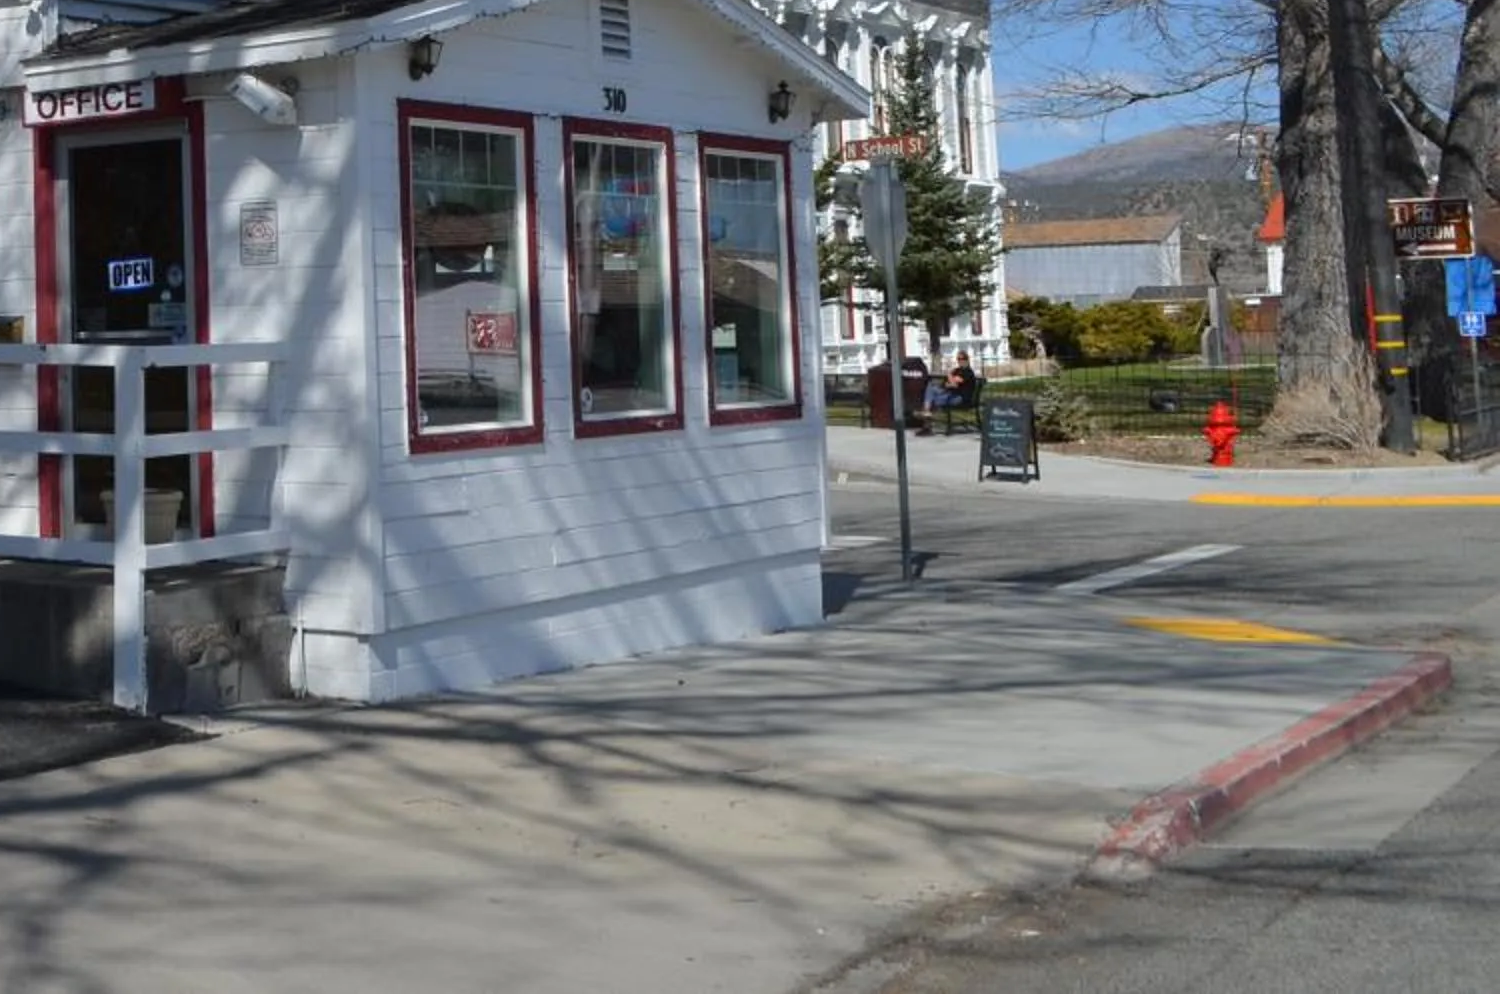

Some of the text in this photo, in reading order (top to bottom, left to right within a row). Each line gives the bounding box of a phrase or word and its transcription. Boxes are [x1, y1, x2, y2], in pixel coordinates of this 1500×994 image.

[37, 84, 143, 119] OFFICE
[602, 87, 626, 113] 310
[846, 142, 857, 159] N
[909, 138, 921, 155] St
[1396, 225, 1456, 240] MUSEUM
[112, 260, 151, 287] OPEN
